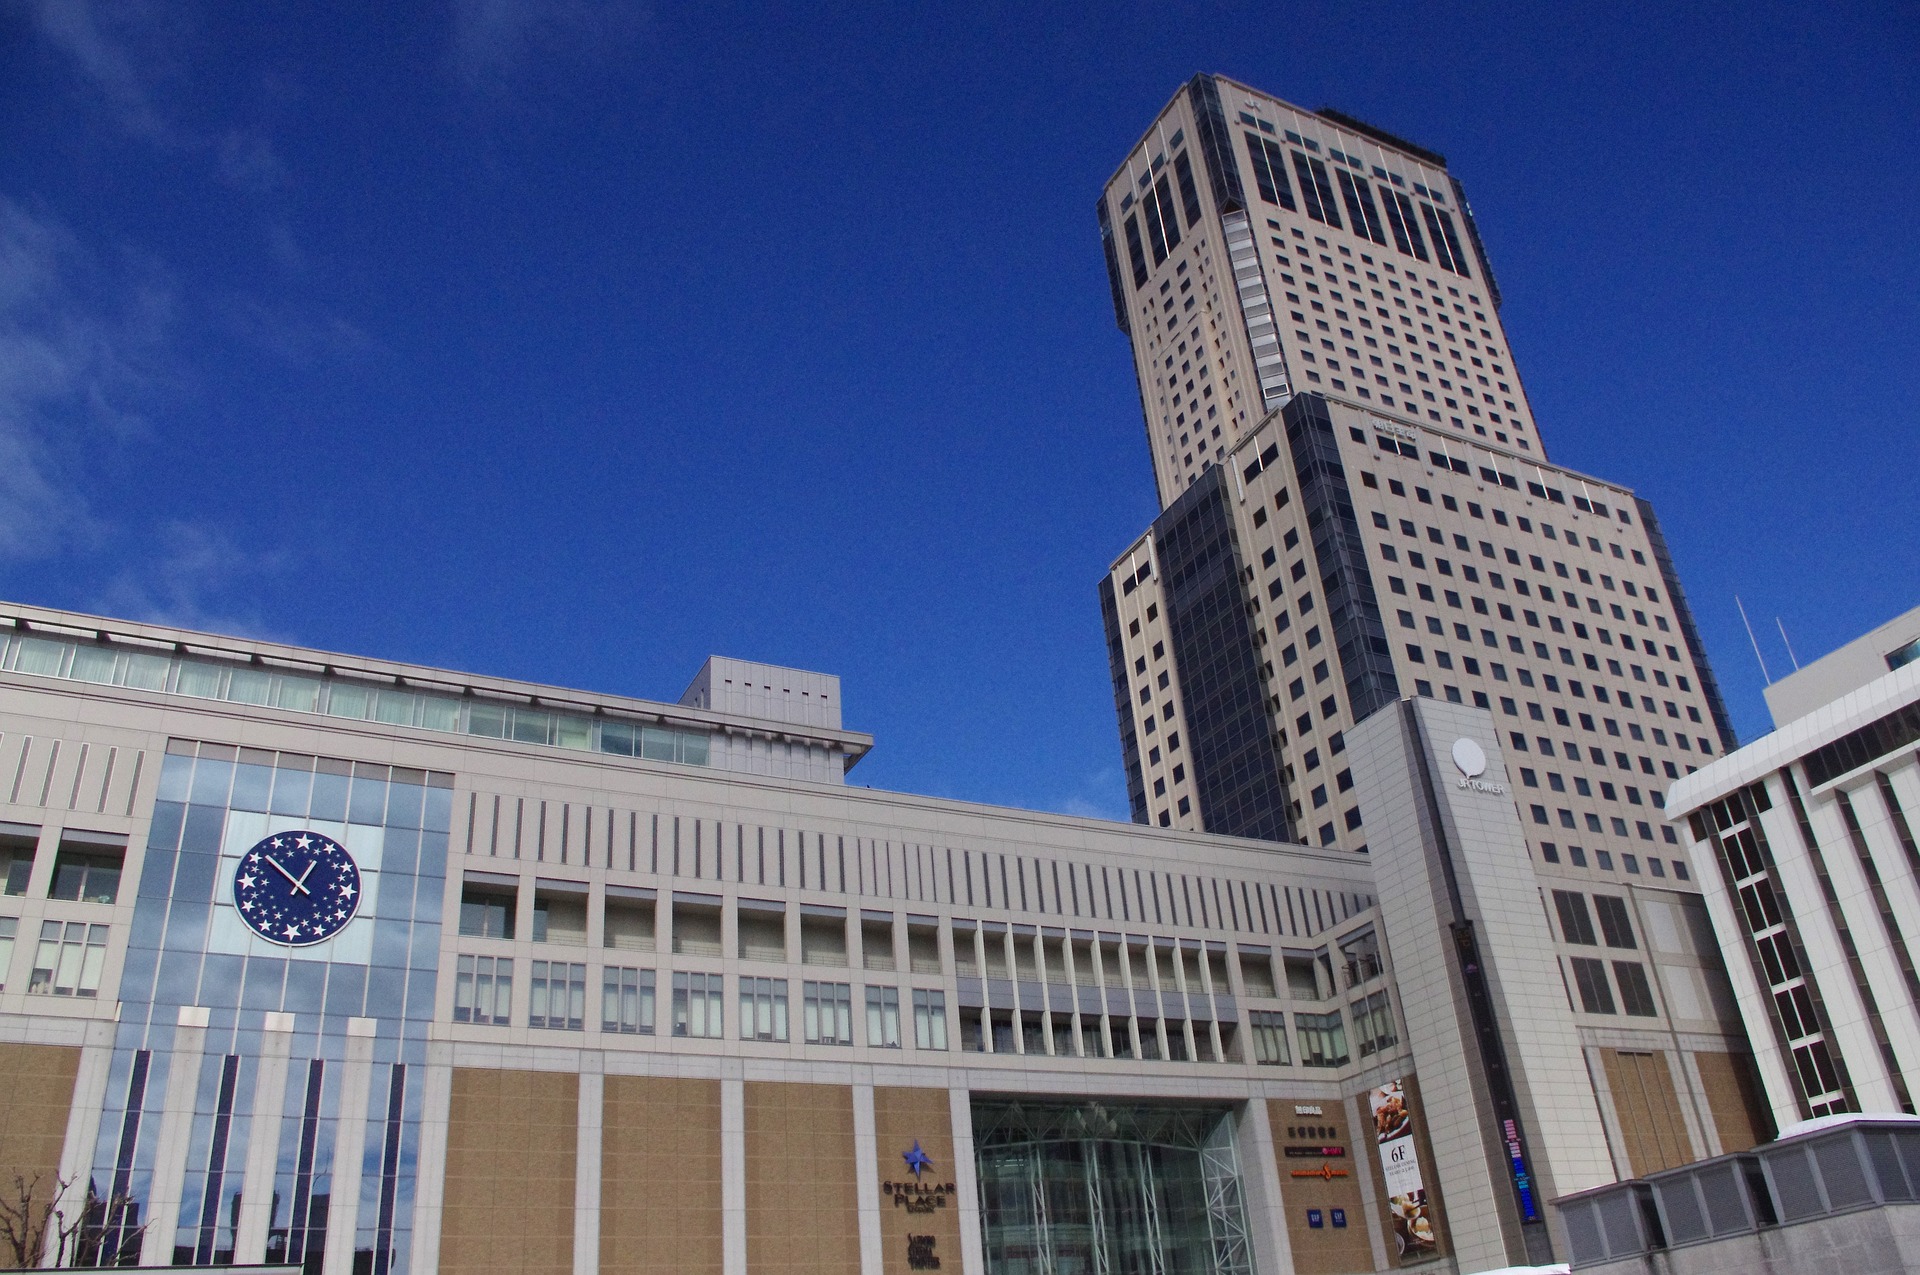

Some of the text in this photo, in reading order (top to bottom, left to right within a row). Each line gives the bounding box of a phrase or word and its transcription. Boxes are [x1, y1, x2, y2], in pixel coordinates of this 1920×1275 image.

[1391, 1145, 1405, 1162] 6F
[883, 1181, 955, 1194] STELLAR
[894, 1194, 945, 1208] PLACE
